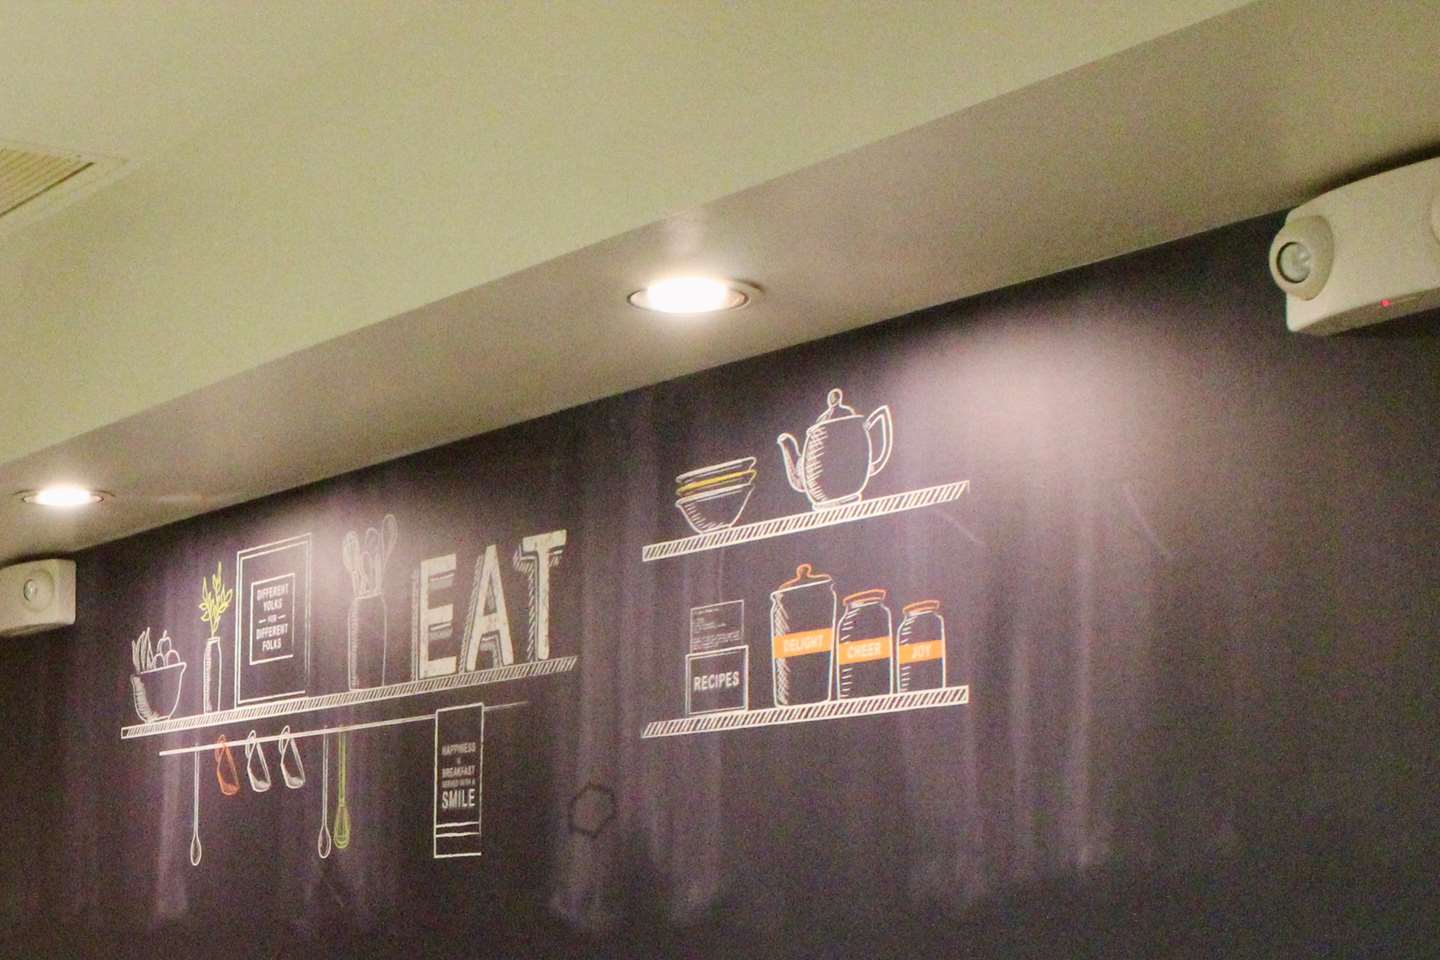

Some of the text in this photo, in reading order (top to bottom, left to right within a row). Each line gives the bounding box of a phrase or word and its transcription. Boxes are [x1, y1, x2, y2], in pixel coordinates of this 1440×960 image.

[257, 583, 289, 601] DIFFERENT
[413, 529, 567, 680] EAT
[256, 623, 288, 640] DIFFERENT
[262, 638, 282, 652] FOLKS
[784, 634, 824, 651] DELIGHT
[847, 642, 881, 659] CHEER
[912, 645, 932, 659] JOY
[693, 671, 740, 691] RECIPES
[441, 788, 476, 809] SMILE
